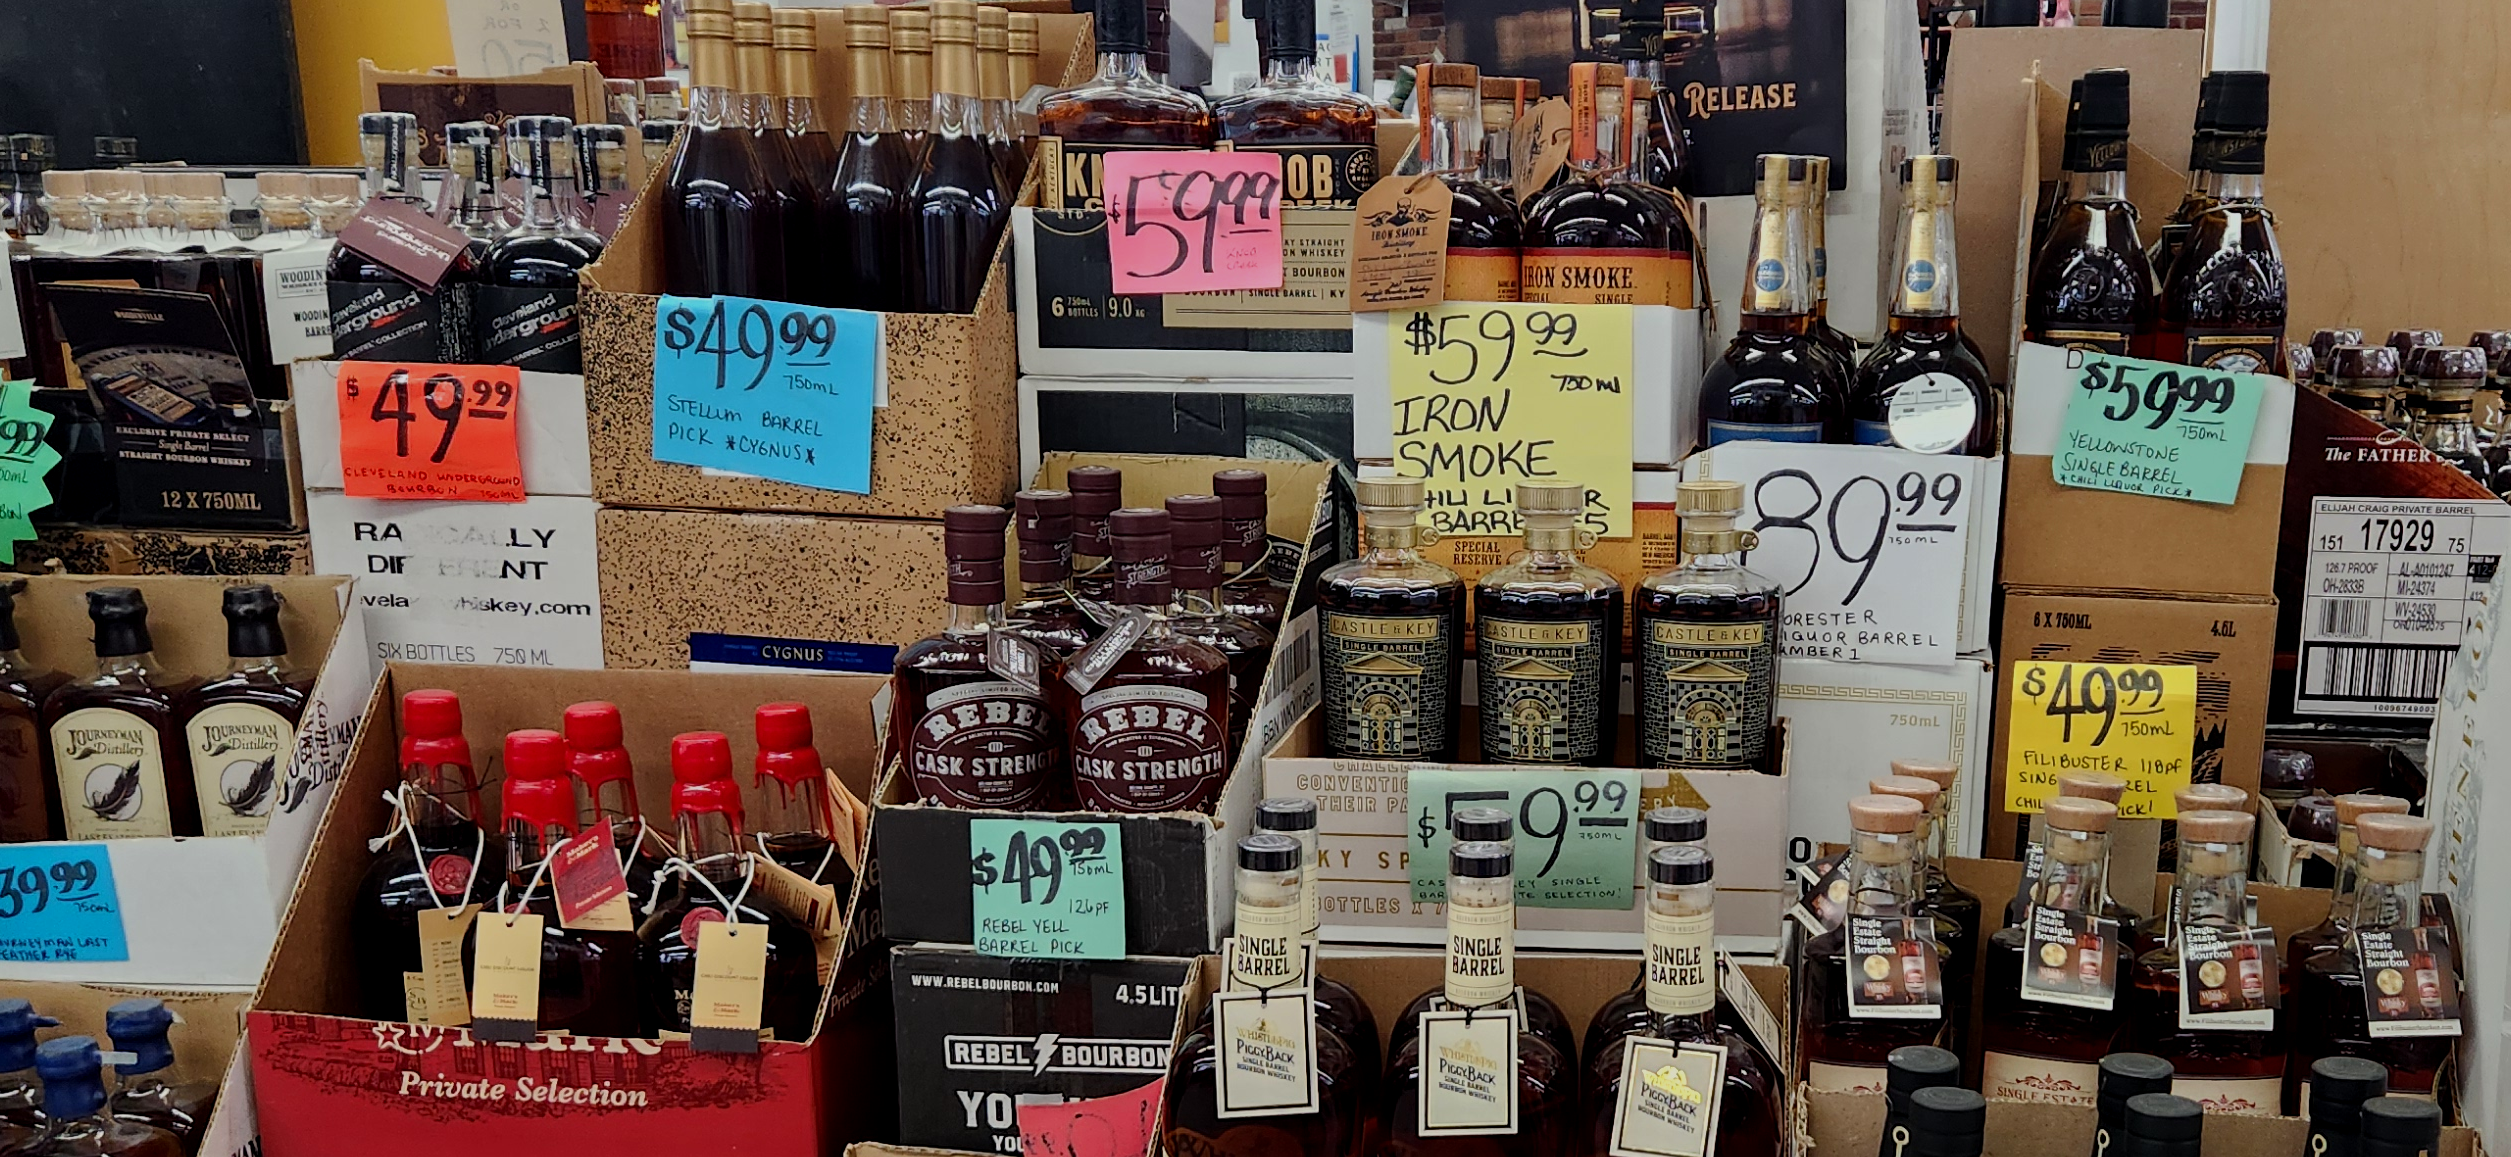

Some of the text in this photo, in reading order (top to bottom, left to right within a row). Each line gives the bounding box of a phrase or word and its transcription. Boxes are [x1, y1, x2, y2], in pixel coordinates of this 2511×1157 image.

[1299, 239, 1345, 247] STRAIGHT
[1300, 249, 1345, 258] WHISKEY
[1292, 267, 1346, 278] BOURBON
[1524, 267, 1634, 289] IRON SMOKE
[1249, 289, 1346, 298] SINGLE BARREL KY
[491, 293, 558, 330] Cleveland
[1052, 299, 1132, 319] 6 BOTTLES 9.0
[663, 299, 837, 392] $49.99
[2080, 358, 2236, 430] $59.99
[346, 368, 514, 463] $49.99
[1393, 388, 1511, 436] IRON
[762, 410, 823, 437] BARREL
[115, 426, 251, 443] EXCLUSIVE PRIVATE SELECT
[668, 421, 713, 446] PICK
[158, 438, 210, 452] Single Barrel
[2069, 430, 2180, 462] YELLOWSTONE
[118, 450, 252, 467] STRAIGHT BOURBON WHISKEY
[1397, 440, 1558, 482] SMOKE
[2325, 446, 2430, 463] The FATHER
[344, 467, 521, 487] CLEVELAND UNDERGROUND
[2061, 452, 2183, 485] SINGLE BARREL
[160, 490, 262, 511] 12 X 750ML
[2321, 503, 2476, 515] ELIJAH CRAIG PRIVATE BARREL
[2320, 517, 2465, 552] 151 17929 75
[1454, 540, 1501, 554] SPECIAL
[1453, 553, 1502, 566] RESERVE
[2325, 562, 2379, 575] 126.7 PROOF
[1332, 618, 1436, 636] CASTLE KEY
[1485, 622, 1585, 641] CASTLE KEY
[1655, 626, 1761, 642] CASTLE KEY
[1345, 641, 1421, 652] SINGLE BARREL
[1858, 631, 1939, 647] BARREL
[377, 642, 401, 660] SIX
[405, 643, 476, 663] BOTTLES
[493, 647, 527, 665] 750
[761, 645, 825, 663] CYGNUS
[1496, 645, 1569, 657] SINGLE BARREL
[1669, 649, 1747, 659] SINGLE BARREL
[1849, 648, 1861, 661] 1
[2022, 663, 2165, 747] $49.99
[923, 700, 1051, 743] REBEL
[1080, 704, 1209, 746] REBEL
[1890, 714, 1941, 727] 750mL
[66, 728, 144, 756] JOURNEYMAN
[202, 723, 279, 753] JOURNEYMAN
[226, 738, 280, 752] Distillery
[94, 742, 144, 756] Distillery
[915, 751, 965, 777] CASK
[1075, 749, 1223, 782] CASK STRENGTH
[2024, 750, 2128, 772] FILIBUSTER
[1316, 796, 1377, 813] THEIR
[971, 827, 1107, 905] $49.99
[1551, 876, 1602, 887] SINGLE
[1544, 887, 1622, 900] SELECTION!
[2035, 914, 2066, 928] Estate
[2036, 905, 2067, 920] Single
[982, 917, 1070, 934] REBEL YELL
[1852, 917, 1882, 929] Single
[1853, 926, 1882, 938] Estate
[2034, 923, 2074, 938] Straight
[77, 938, 108, 948] LAST
[978, 936, 1086, 955] BARREL PICK
[1238, 933, 1288, 957] SINGLE
[1452, 934, 1502, 957] SINGLE
[1853, 935, 1893, 948] Straight
[2034, 931, 2078, 946] Bourbon
[2186, 934, 2218, 943] Estate
[2361, 931, 2393, 942] Single
[2362, 940, 2393, 950] Estate
[55, 947, 78, 961] RYE
[1651, 943, 1701, 967] SINGLE
[1854, 944, 1897, 954] Bourbon
[2187, 940, 2229, 952] Straight
[2189, 949, 2234, 960] Bourbon
[2364, 949, 2405, 960] Straight
[1237, 956, 1291, 977] BARREL
[1452, 956, 1505, 977] BARREL
[2366, 958, 2411, 968] Bourbon
[911, 974, 1060, 994] WWW.REBELBOURBON.COM
[1650, 965, 1705, 987] BARREL
[1115, 984, 1147, 1005] 4.5
[953, 1042, 1170, 1068] REBEL BOURBON
[1236, 1062, 1297, 1084] BOURBON WHISKEY
[1242, 1055, 1291, 1074] SINGLE BARREL
[398, 1070, 649, 1108] Private Selection
[1438, 1081, 1497, 1104] BOURBON WHISKEY
[1444, 1074, 1491, 1094] SINGLE BARREL
[1637, 1104, 1696, 1135] BOURBON WHISKEY
